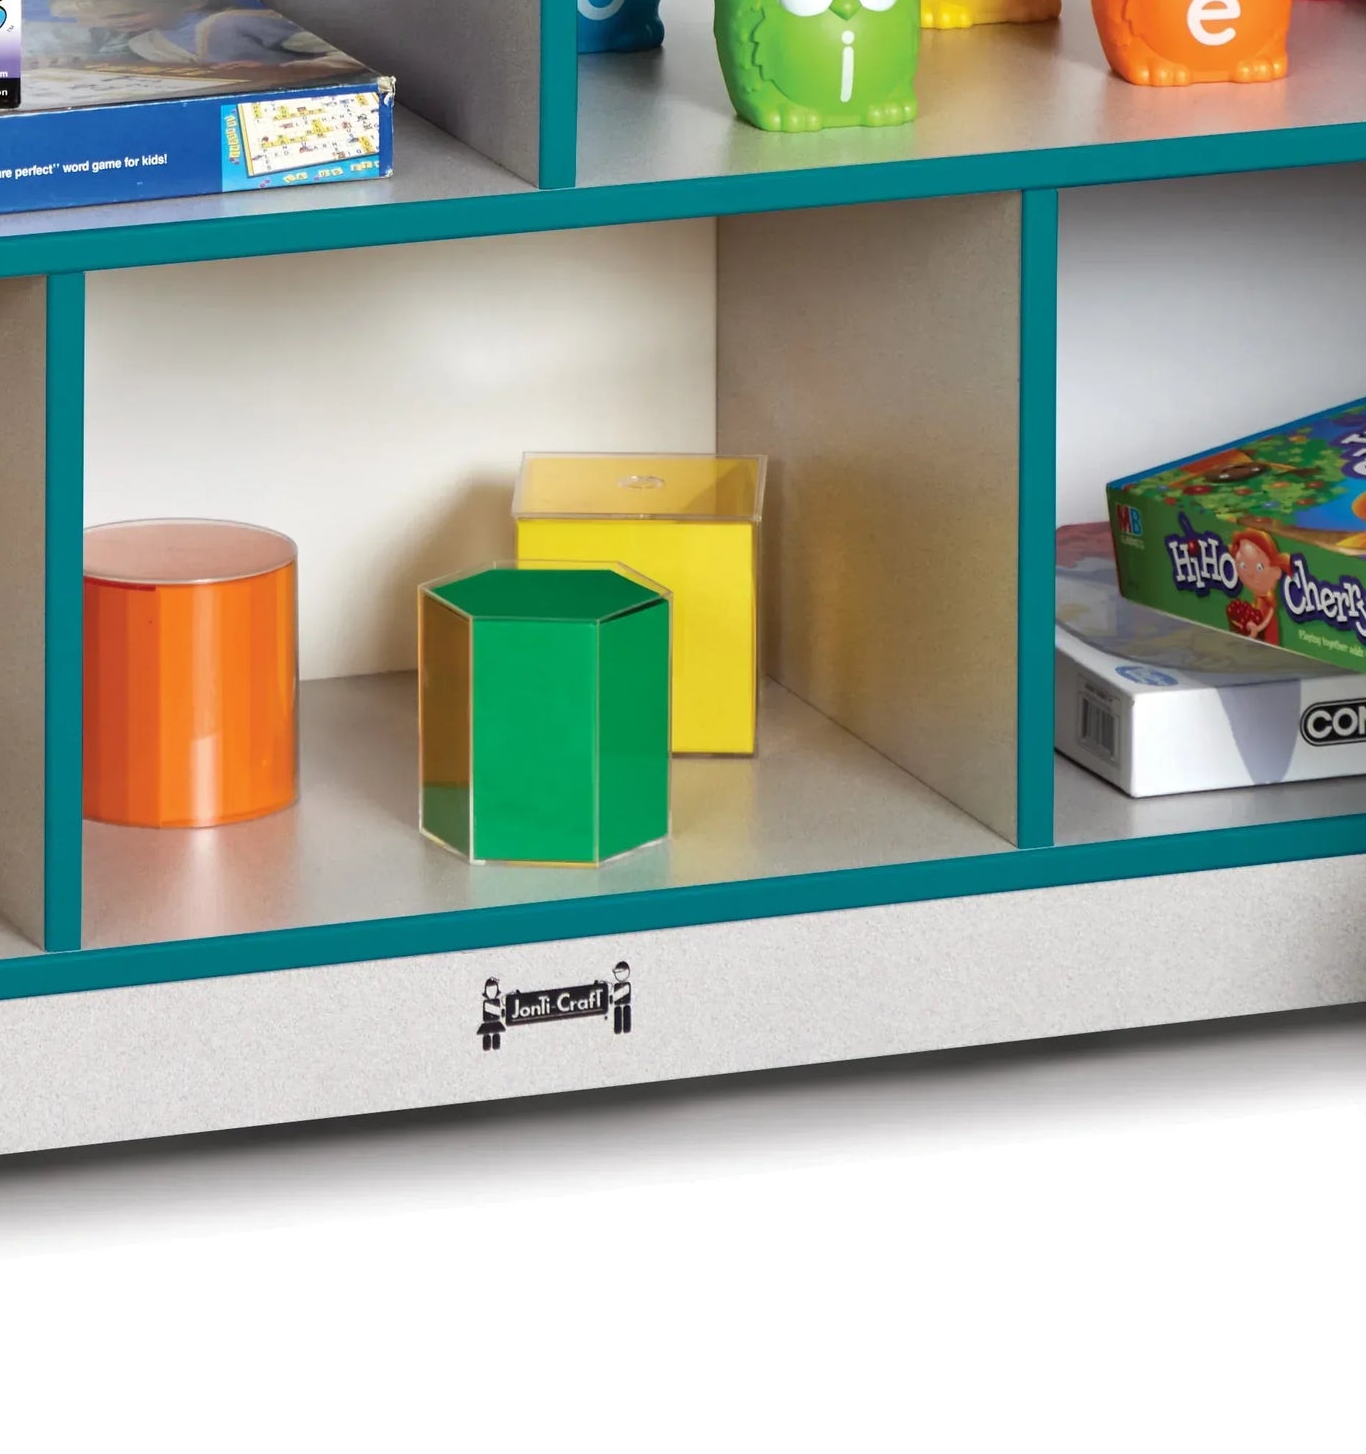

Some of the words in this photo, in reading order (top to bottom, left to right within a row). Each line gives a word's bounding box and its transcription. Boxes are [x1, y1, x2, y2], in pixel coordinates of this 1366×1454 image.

[840, 30, 855, 103] i
[15, 163, 59, 179] perfect"
[62, 161, 89, 174] word
[92, 160, 122, 173] game
[124, 157, 140, 168] for
[142, 154, 168, 166] kids!
[1116, 504, 1142, 536] MB
[1169, 537, 1237, 589] HiHo
